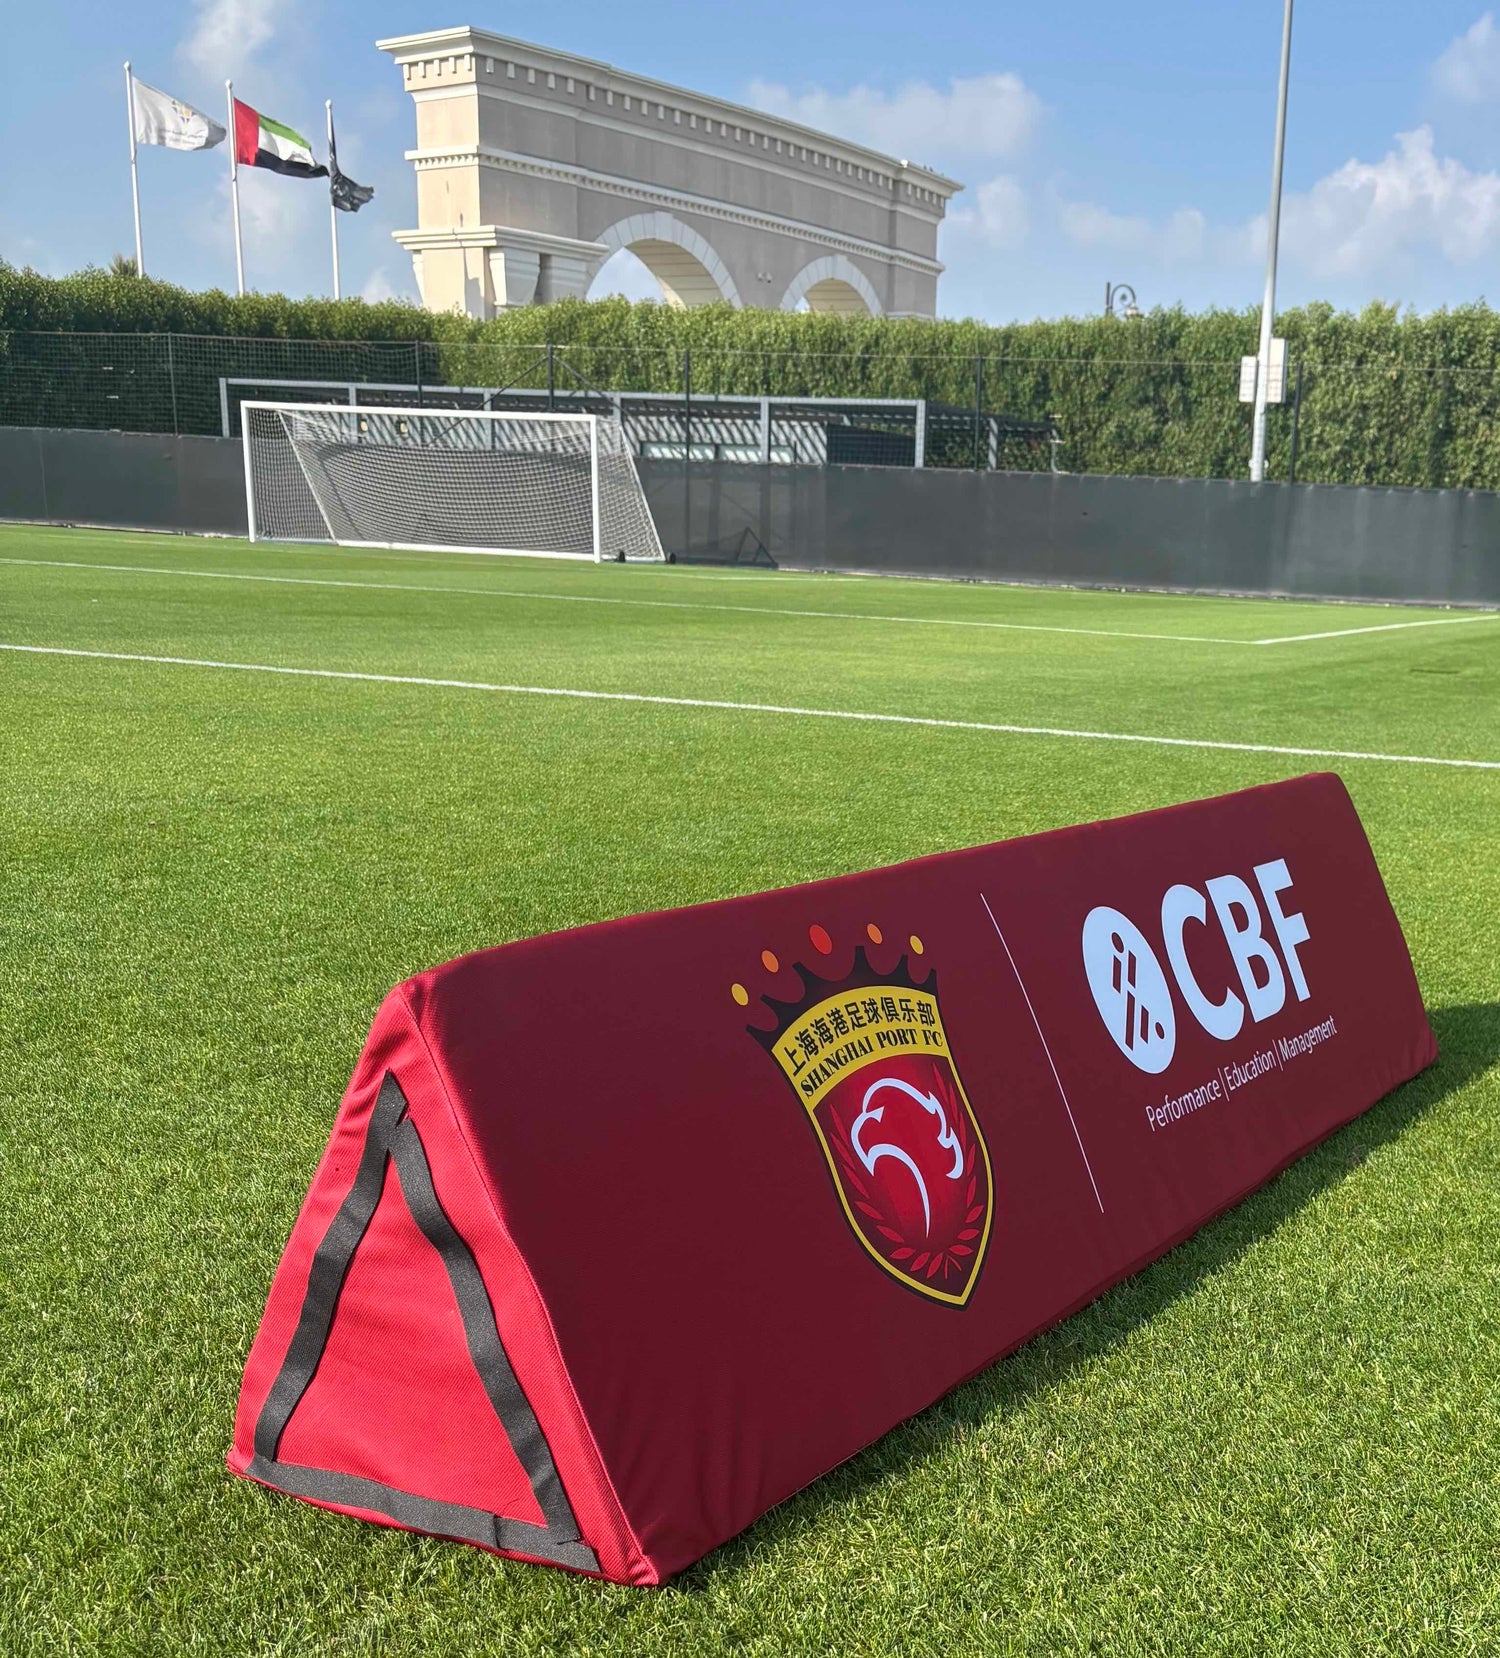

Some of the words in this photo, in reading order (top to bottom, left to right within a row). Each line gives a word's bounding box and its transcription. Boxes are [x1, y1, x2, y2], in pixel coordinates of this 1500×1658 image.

[1161, 858, 1311, 1041] CBF
[783, 996, 935, 1077] 上海海港足球俱乐部
[801, 1036, 875, 1098] SHANGHAI
[876, 1029, 918, 1049] PORT
[922, 1029, 943, 1048] FC
[1145, 1078, 1222, 1132] Performance
[1223, 1048, 1277, 1091] Education
[1278, 1015, 1338, 1062] Management
